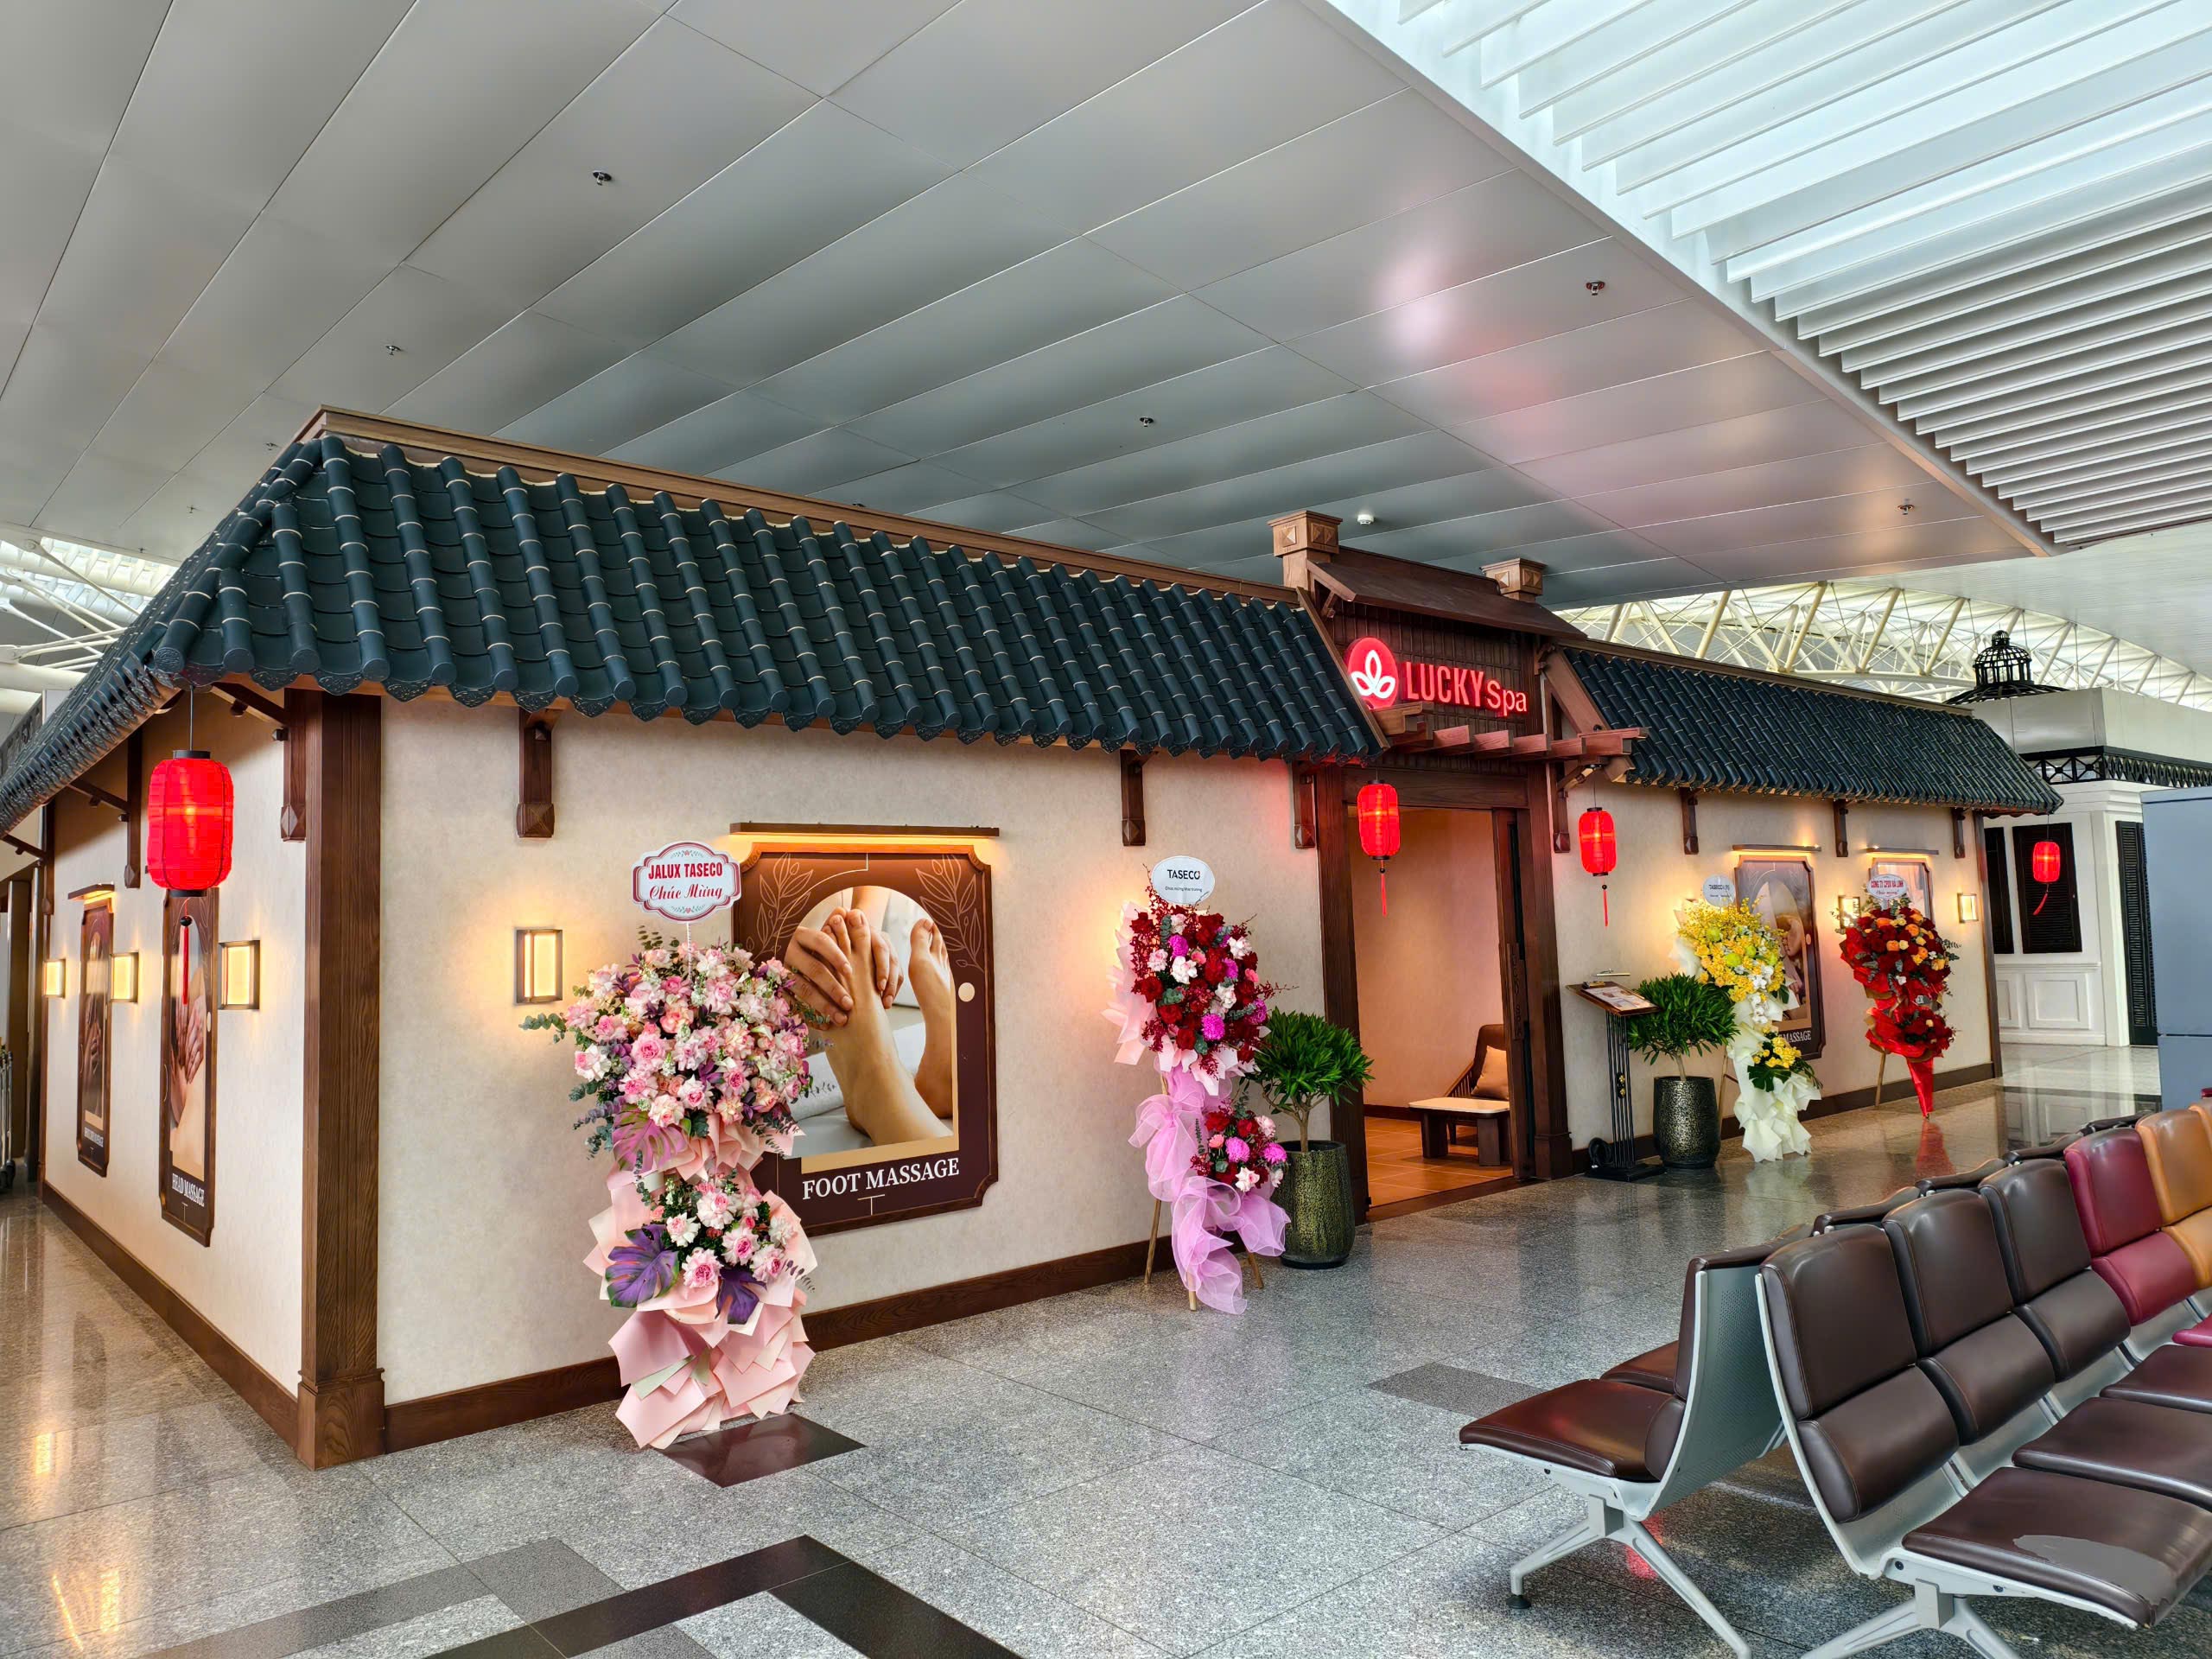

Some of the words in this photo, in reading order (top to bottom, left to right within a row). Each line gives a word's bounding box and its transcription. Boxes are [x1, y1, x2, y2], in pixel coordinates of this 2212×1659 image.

[1405, 661, 1484, 707] LUCKY
[1486, 679, 1528, 717] Spa
[648, 864, 681, 880] JALUX
[684, 862, 722, 877] TASECO
[1167, 869, 1201, 880] TASECO
[650, 886, 681, 900] Chúc
[1783, 1030, 1812, 1043] MASSAGE
[802, 1173, 861, 1200] FOOT
[866, 1157, 960, 1190] MASSAGE
[172, 1173, 184, 1194] HEAD
[184, 1179, 205, 1208] MASSAGE
